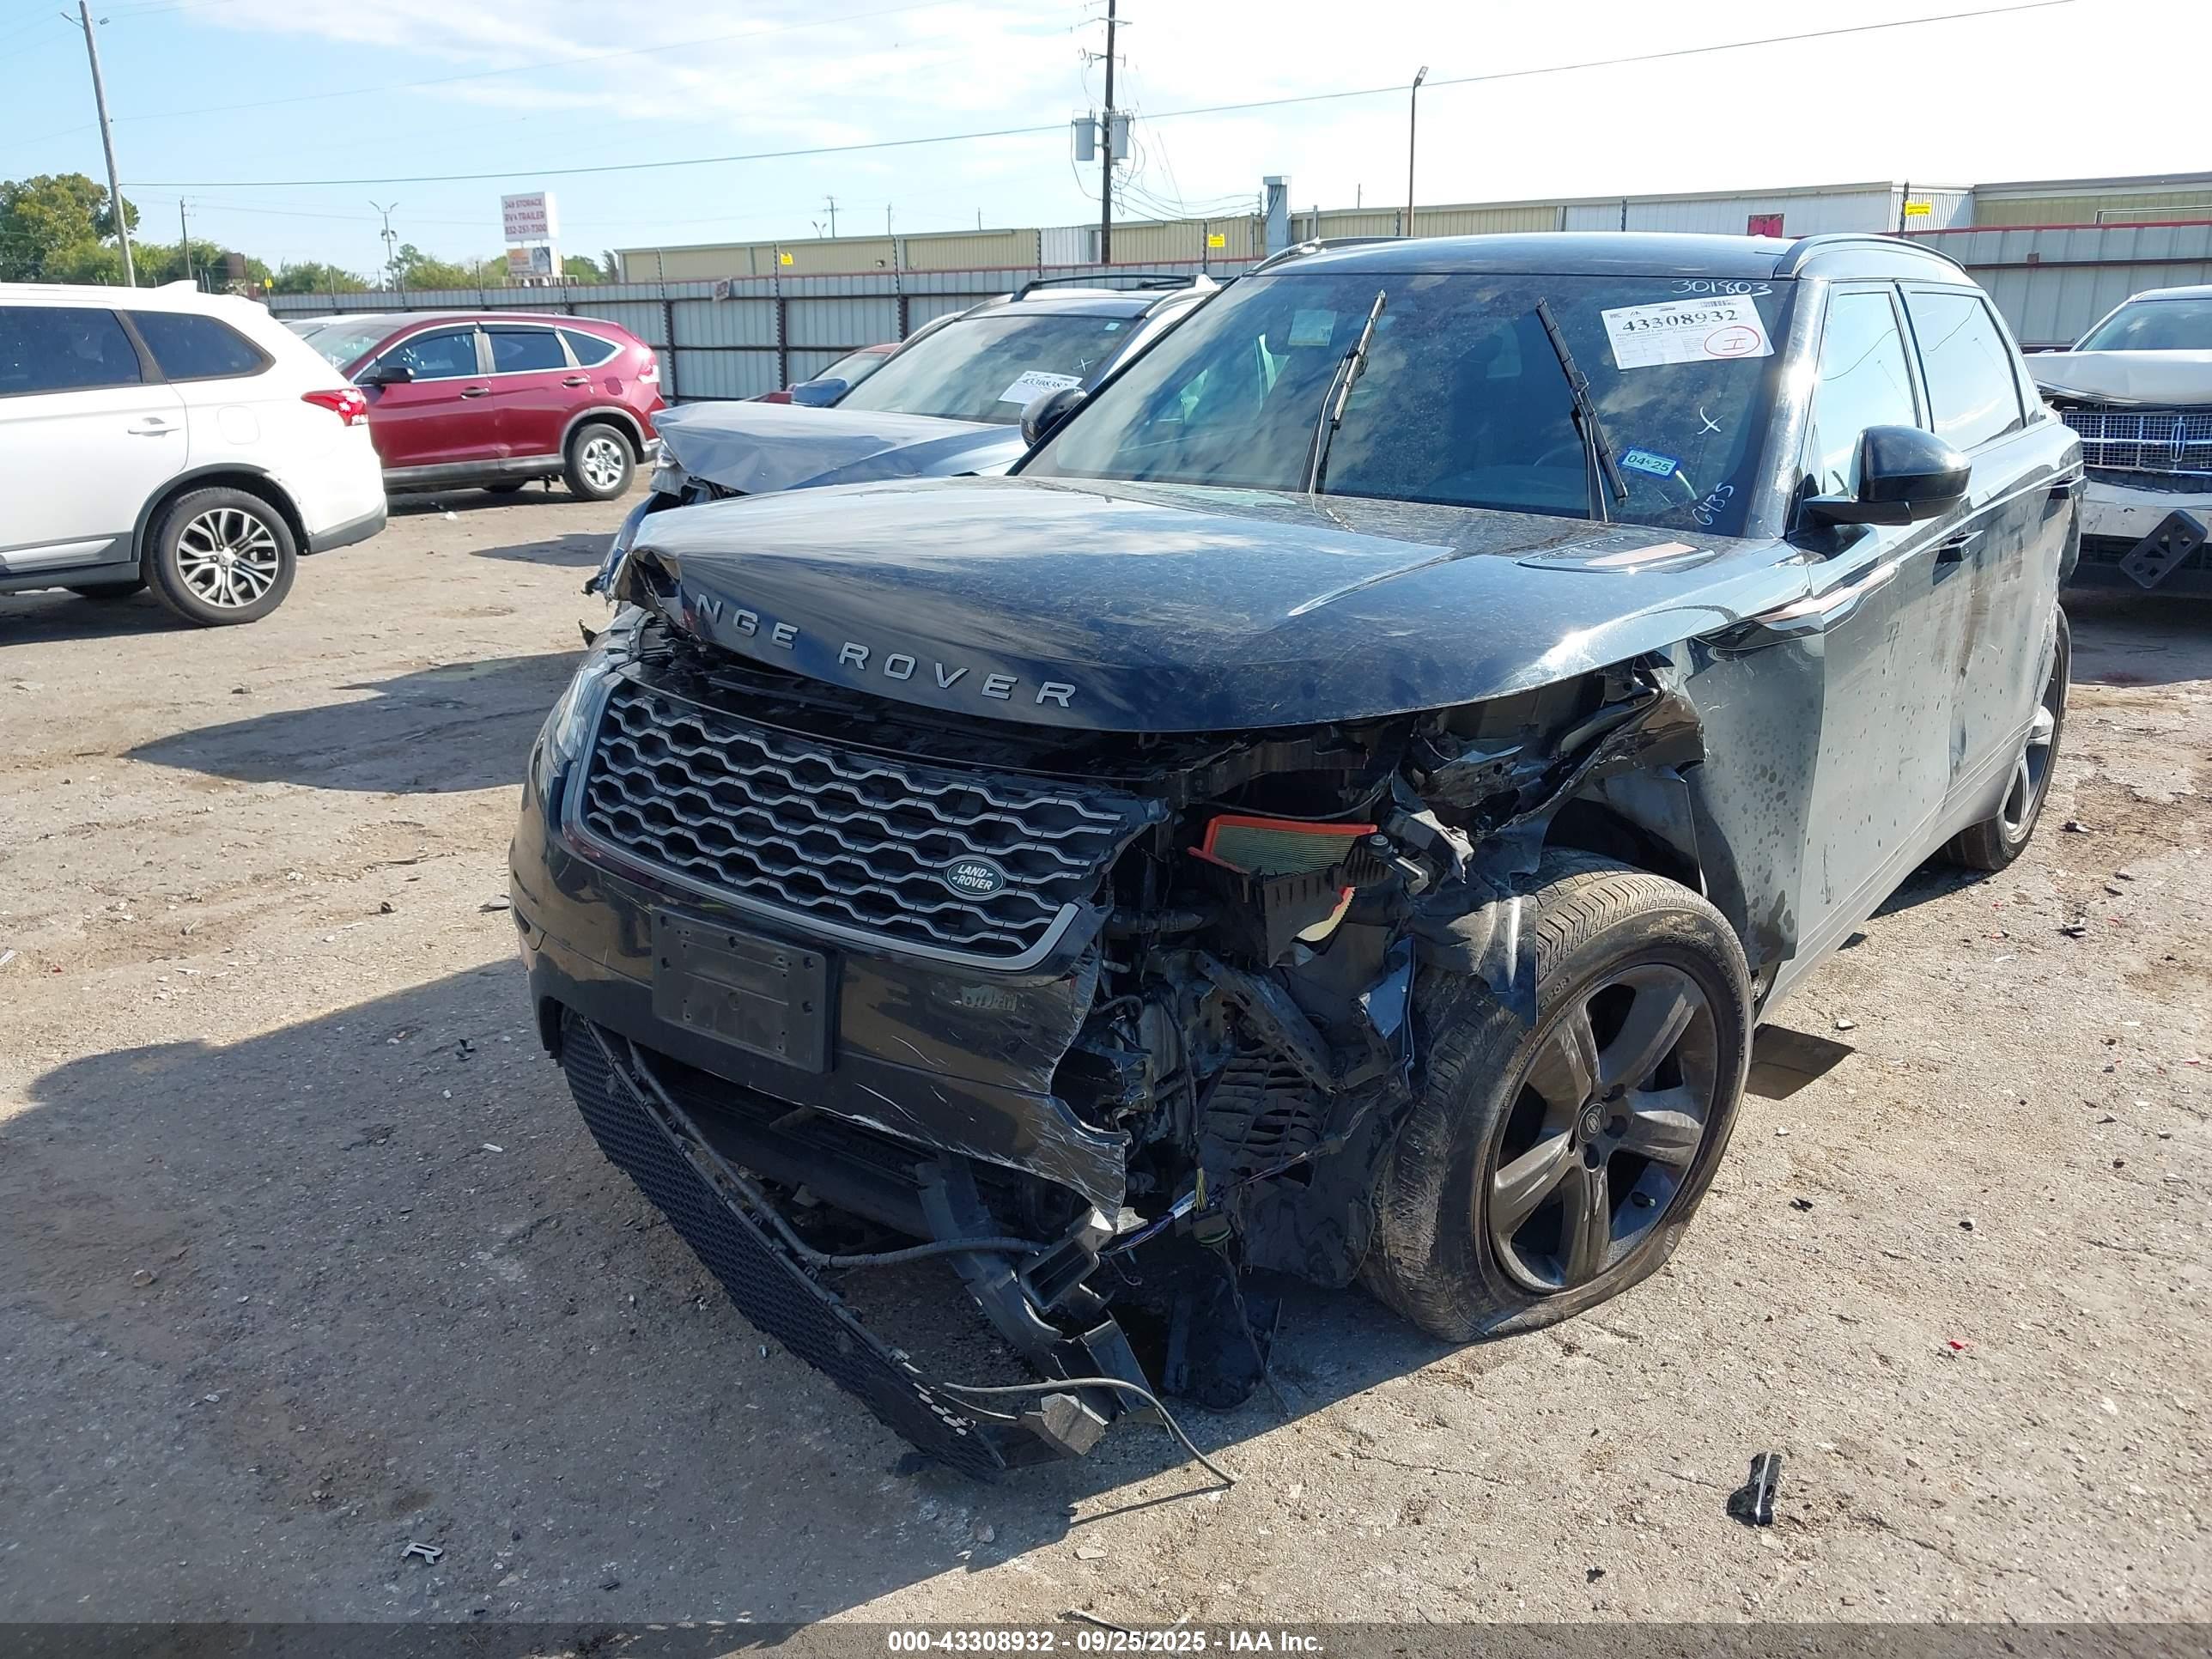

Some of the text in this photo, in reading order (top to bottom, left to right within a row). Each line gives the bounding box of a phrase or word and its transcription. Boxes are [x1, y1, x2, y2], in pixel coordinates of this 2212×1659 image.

[518, 210, 545, 221] TRAILER
[1622, 309, 1738, 332] 43308932
[1650, 460, 1671, 471] 25
[838, 641, 1077, 708] ROVER
[957, 864, 988, 878] LAND
[957, 875, 994, 890] ROVER
